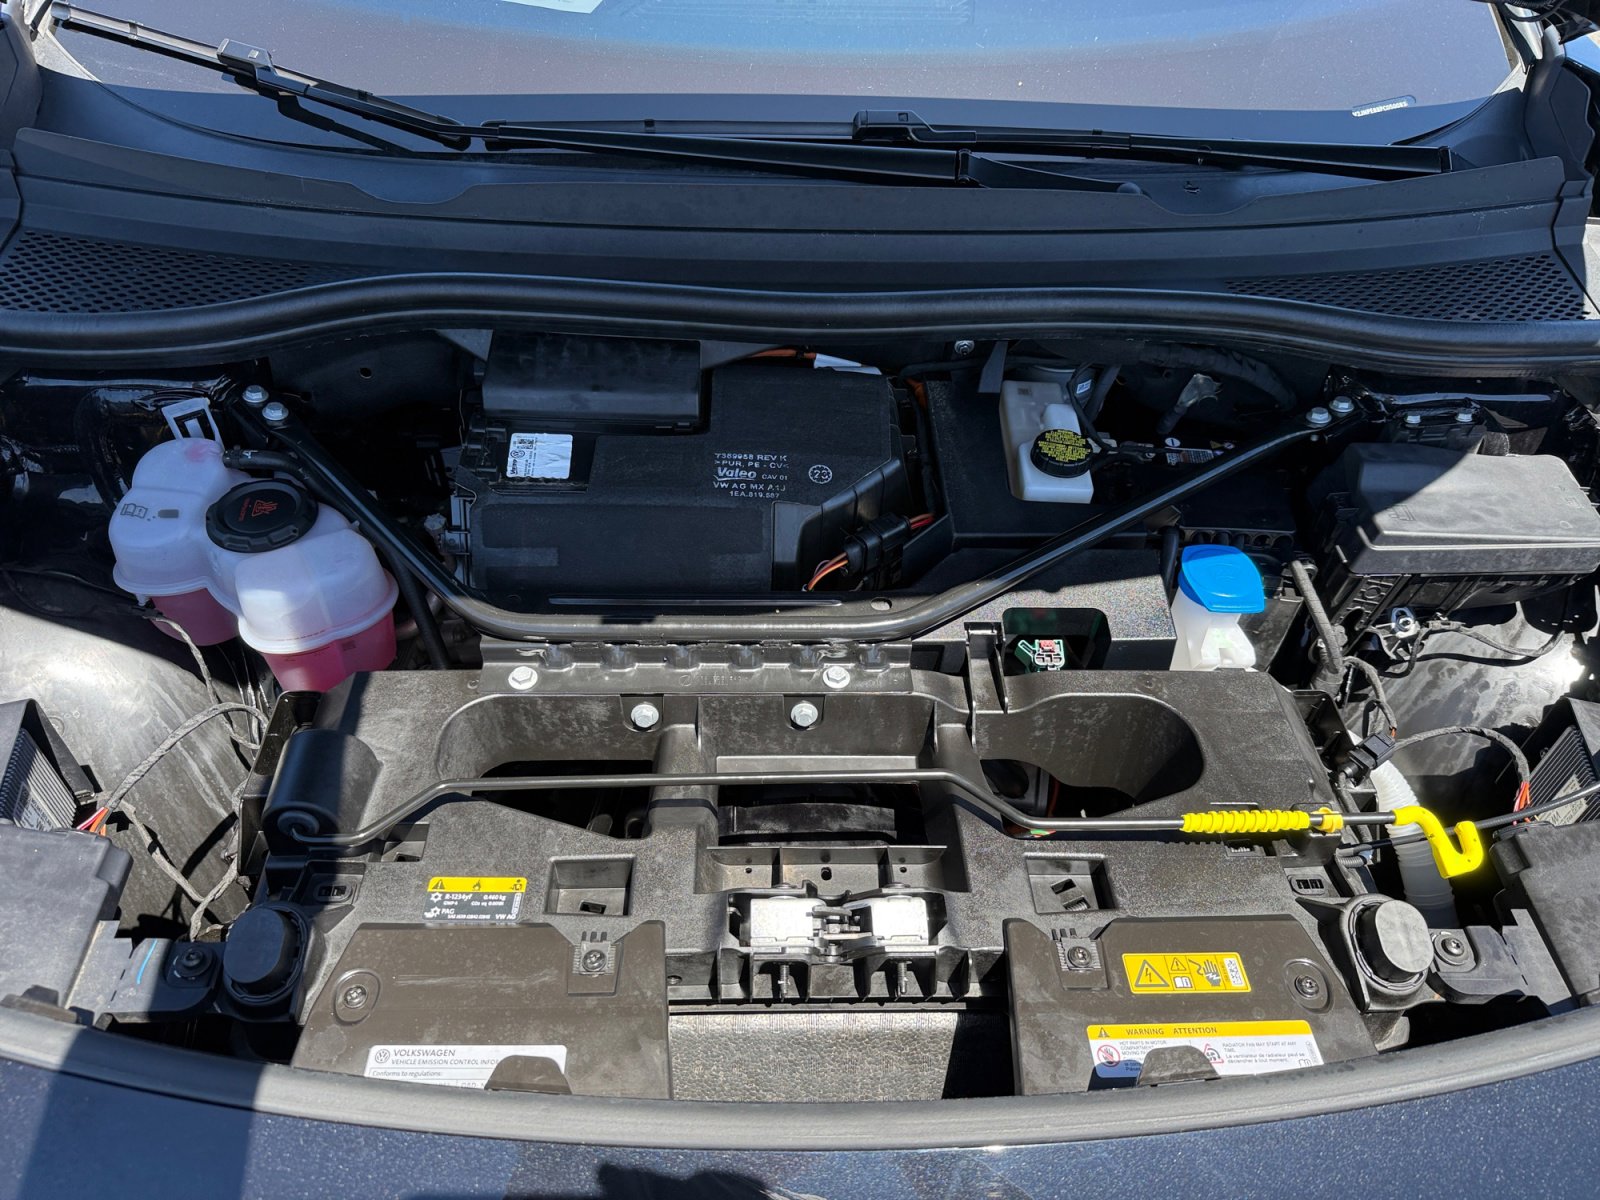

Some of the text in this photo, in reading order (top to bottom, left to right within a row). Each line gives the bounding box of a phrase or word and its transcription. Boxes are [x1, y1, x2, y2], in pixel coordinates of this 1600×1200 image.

[717, 467, 757, 479] Valeo
[814, 470, 828, 480] 23
[1126, 1027, 1217, 1036] WARNING ATTENTION
[393, 1049, 456, 1057] VOLKSWAGEN
